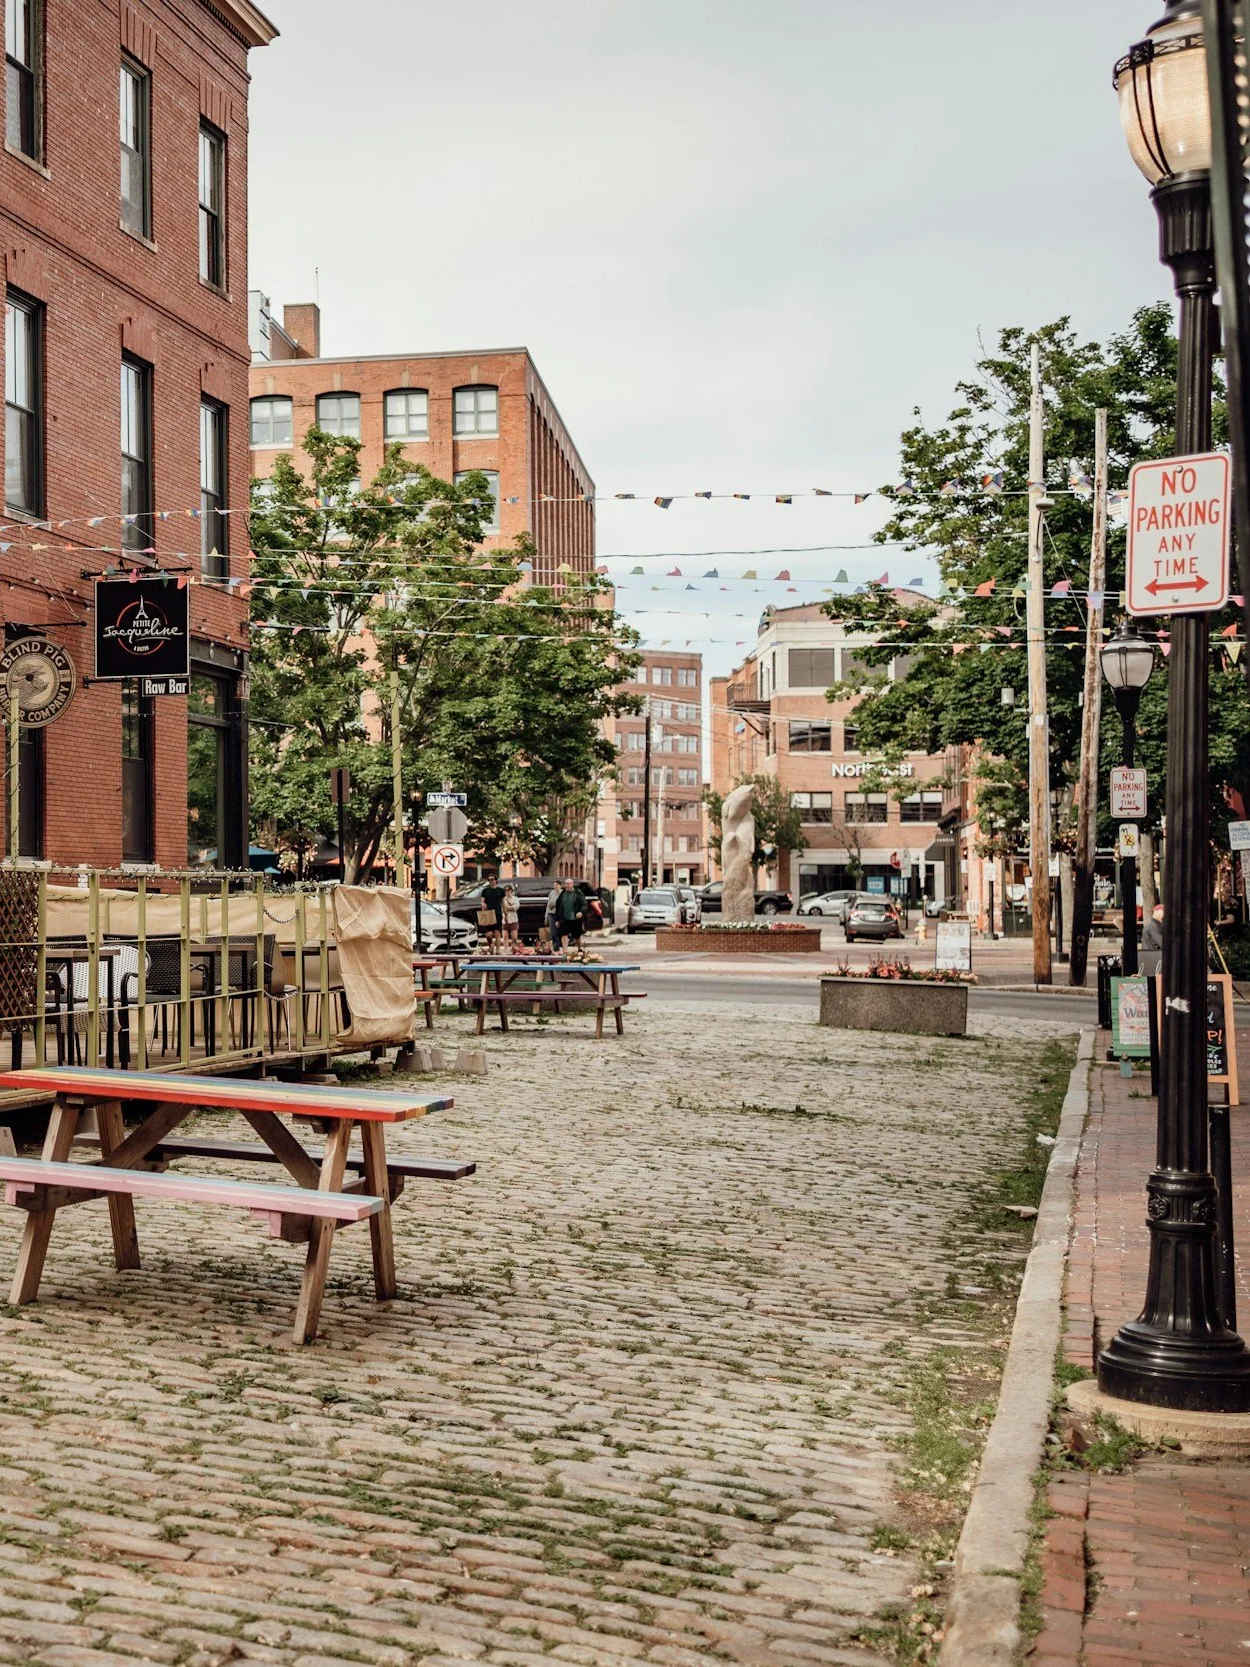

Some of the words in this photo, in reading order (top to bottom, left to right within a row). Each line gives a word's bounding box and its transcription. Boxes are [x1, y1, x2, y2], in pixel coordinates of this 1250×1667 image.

[1161, 467, 1197, 496] NO
[1136, 498, 1221, 533] PARKING
[1158, 533, 1196, 554] ANY
[1153, 556, 1199, 577] TIME
[103, 617, 184, 644] Jacqueline
[132, 620, 151, 628] PETITE
[1, 641, 41, 669] BLIND
[43, 644, 66, 667] PIG
[145, 680, 166, 694] Raw
[169, 679, 187, 693] Bar
[28, 684, 70, 721] COMPANY
[1121, 772, 1135, 781] NO
[1113, 783, 1144, 792] PARKING
[436, 795, 458, 805] Market
